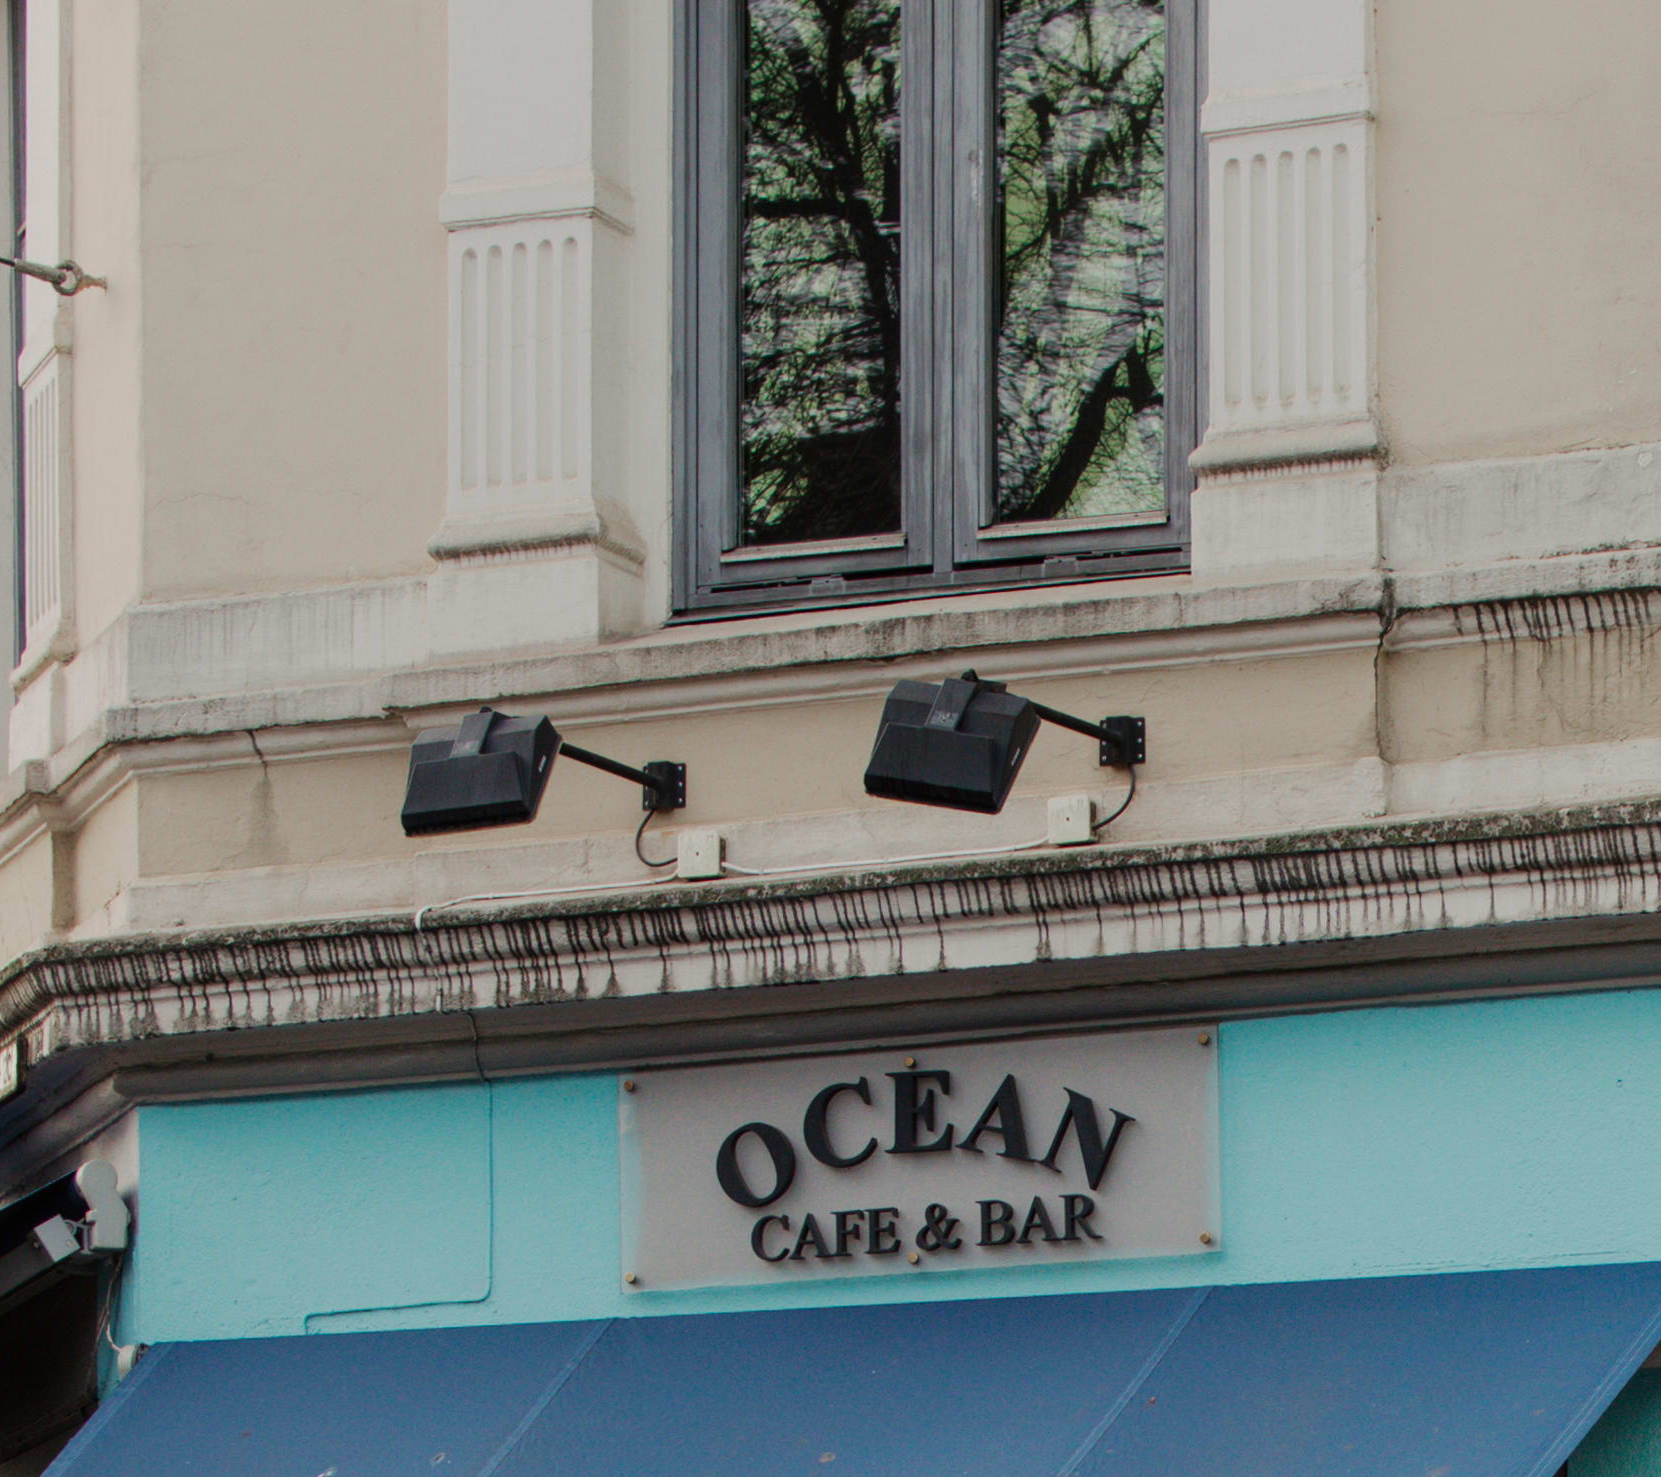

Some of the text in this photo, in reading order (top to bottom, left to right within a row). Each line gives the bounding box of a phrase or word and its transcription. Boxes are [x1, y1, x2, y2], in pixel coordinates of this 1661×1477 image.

[716, 1069, 1136, 1207] OCEAN
[750, 1194, 1103, 1262] CAFE & BAR
